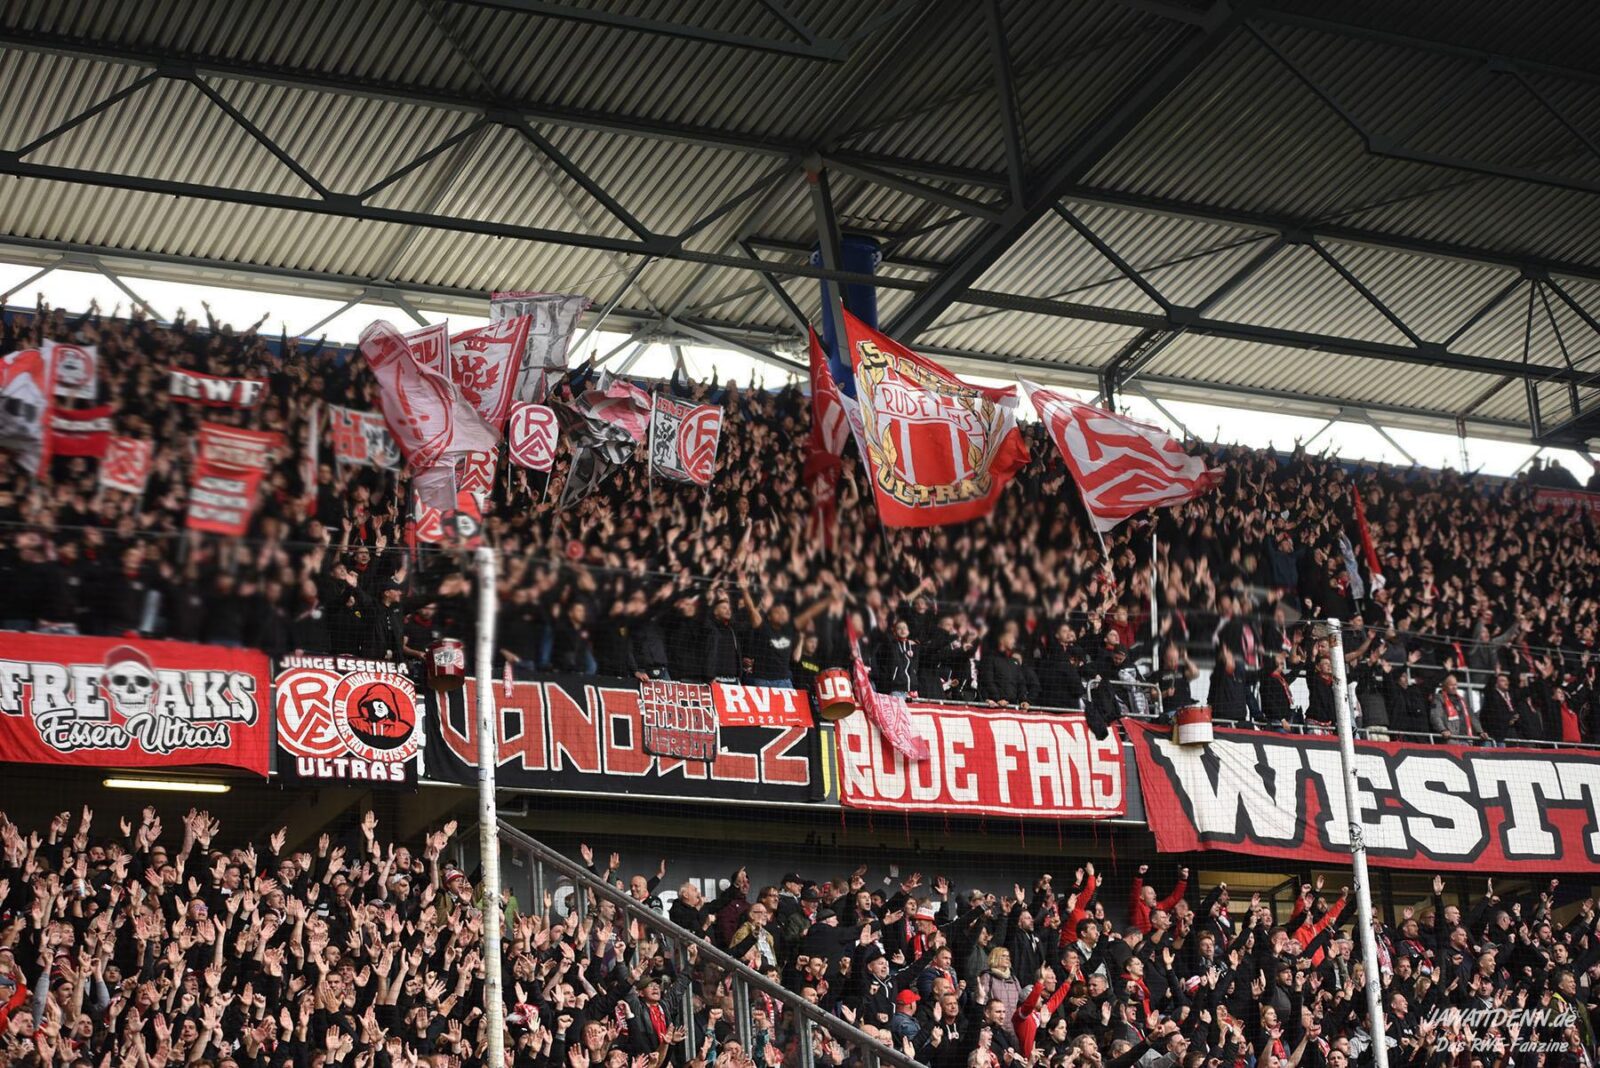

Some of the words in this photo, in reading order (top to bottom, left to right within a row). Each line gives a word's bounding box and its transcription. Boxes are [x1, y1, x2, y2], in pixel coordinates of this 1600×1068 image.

[881, 387, 930, 417] RUDE
[280, 657, 334, 670] JUNGE
[336, 658, 409, 674] ESSENER
[0, 660, 255, 722] FREAKS
[641, 681, 713, 707] GRUPPE
[720, 683, 798, 713] RVT
[38, 709, 128, 750] Essen
[127, 712, 230, 752] Ultras
[435, 676, 811, 786] VANDLZ
[644, 702, 716, 733] STADION
[748, 715, 784, 724] 0221
[298, 757, 406, 781] ULTRAS
[838, 710, 979, 801] RUDE
[990, 719, 1123, 810] FANS
